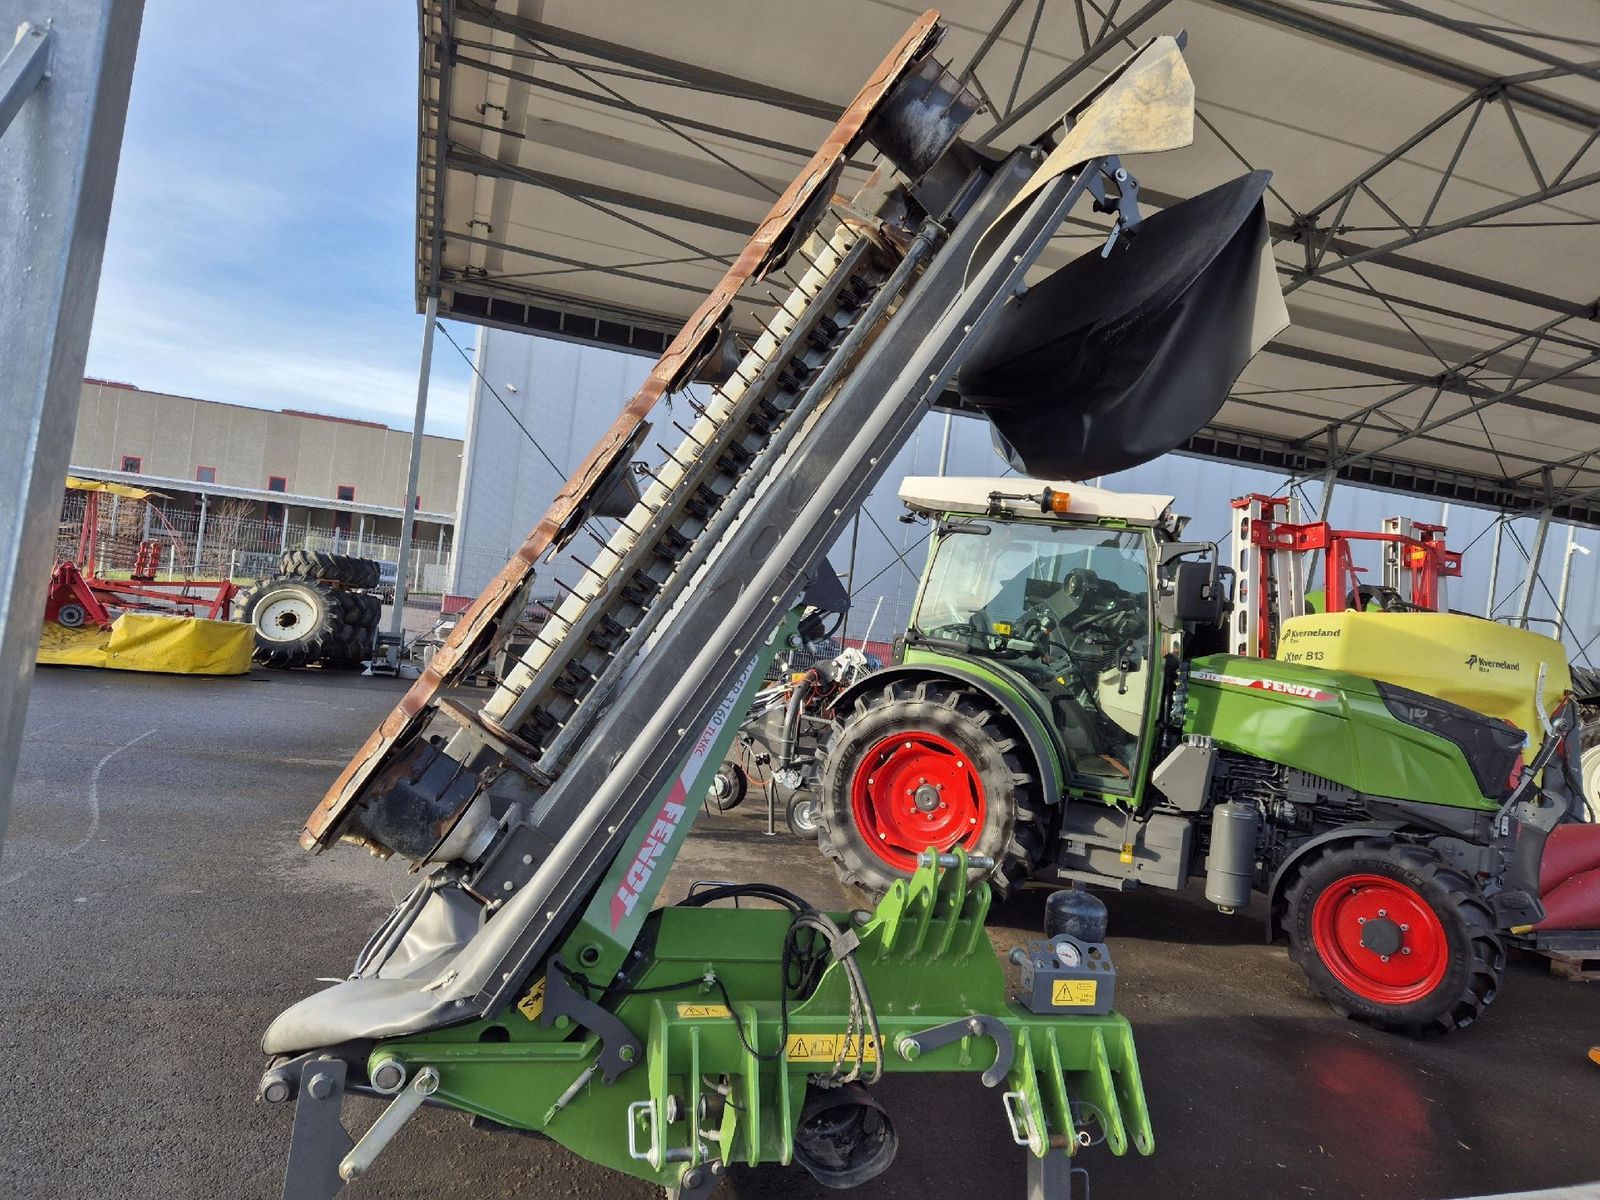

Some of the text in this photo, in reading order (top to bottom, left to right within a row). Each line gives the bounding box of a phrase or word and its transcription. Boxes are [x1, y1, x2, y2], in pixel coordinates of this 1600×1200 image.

[1291, 629, 1341, 638] Kverneland
[1305, 651, 1325, 661] B13
[1479, 657, 1520, 671] Kverneland
[1262, 678, 1322, 699] FENDT
[713, 694, 735, 726] 3160
[617, 801, 687, 917] FENDT
